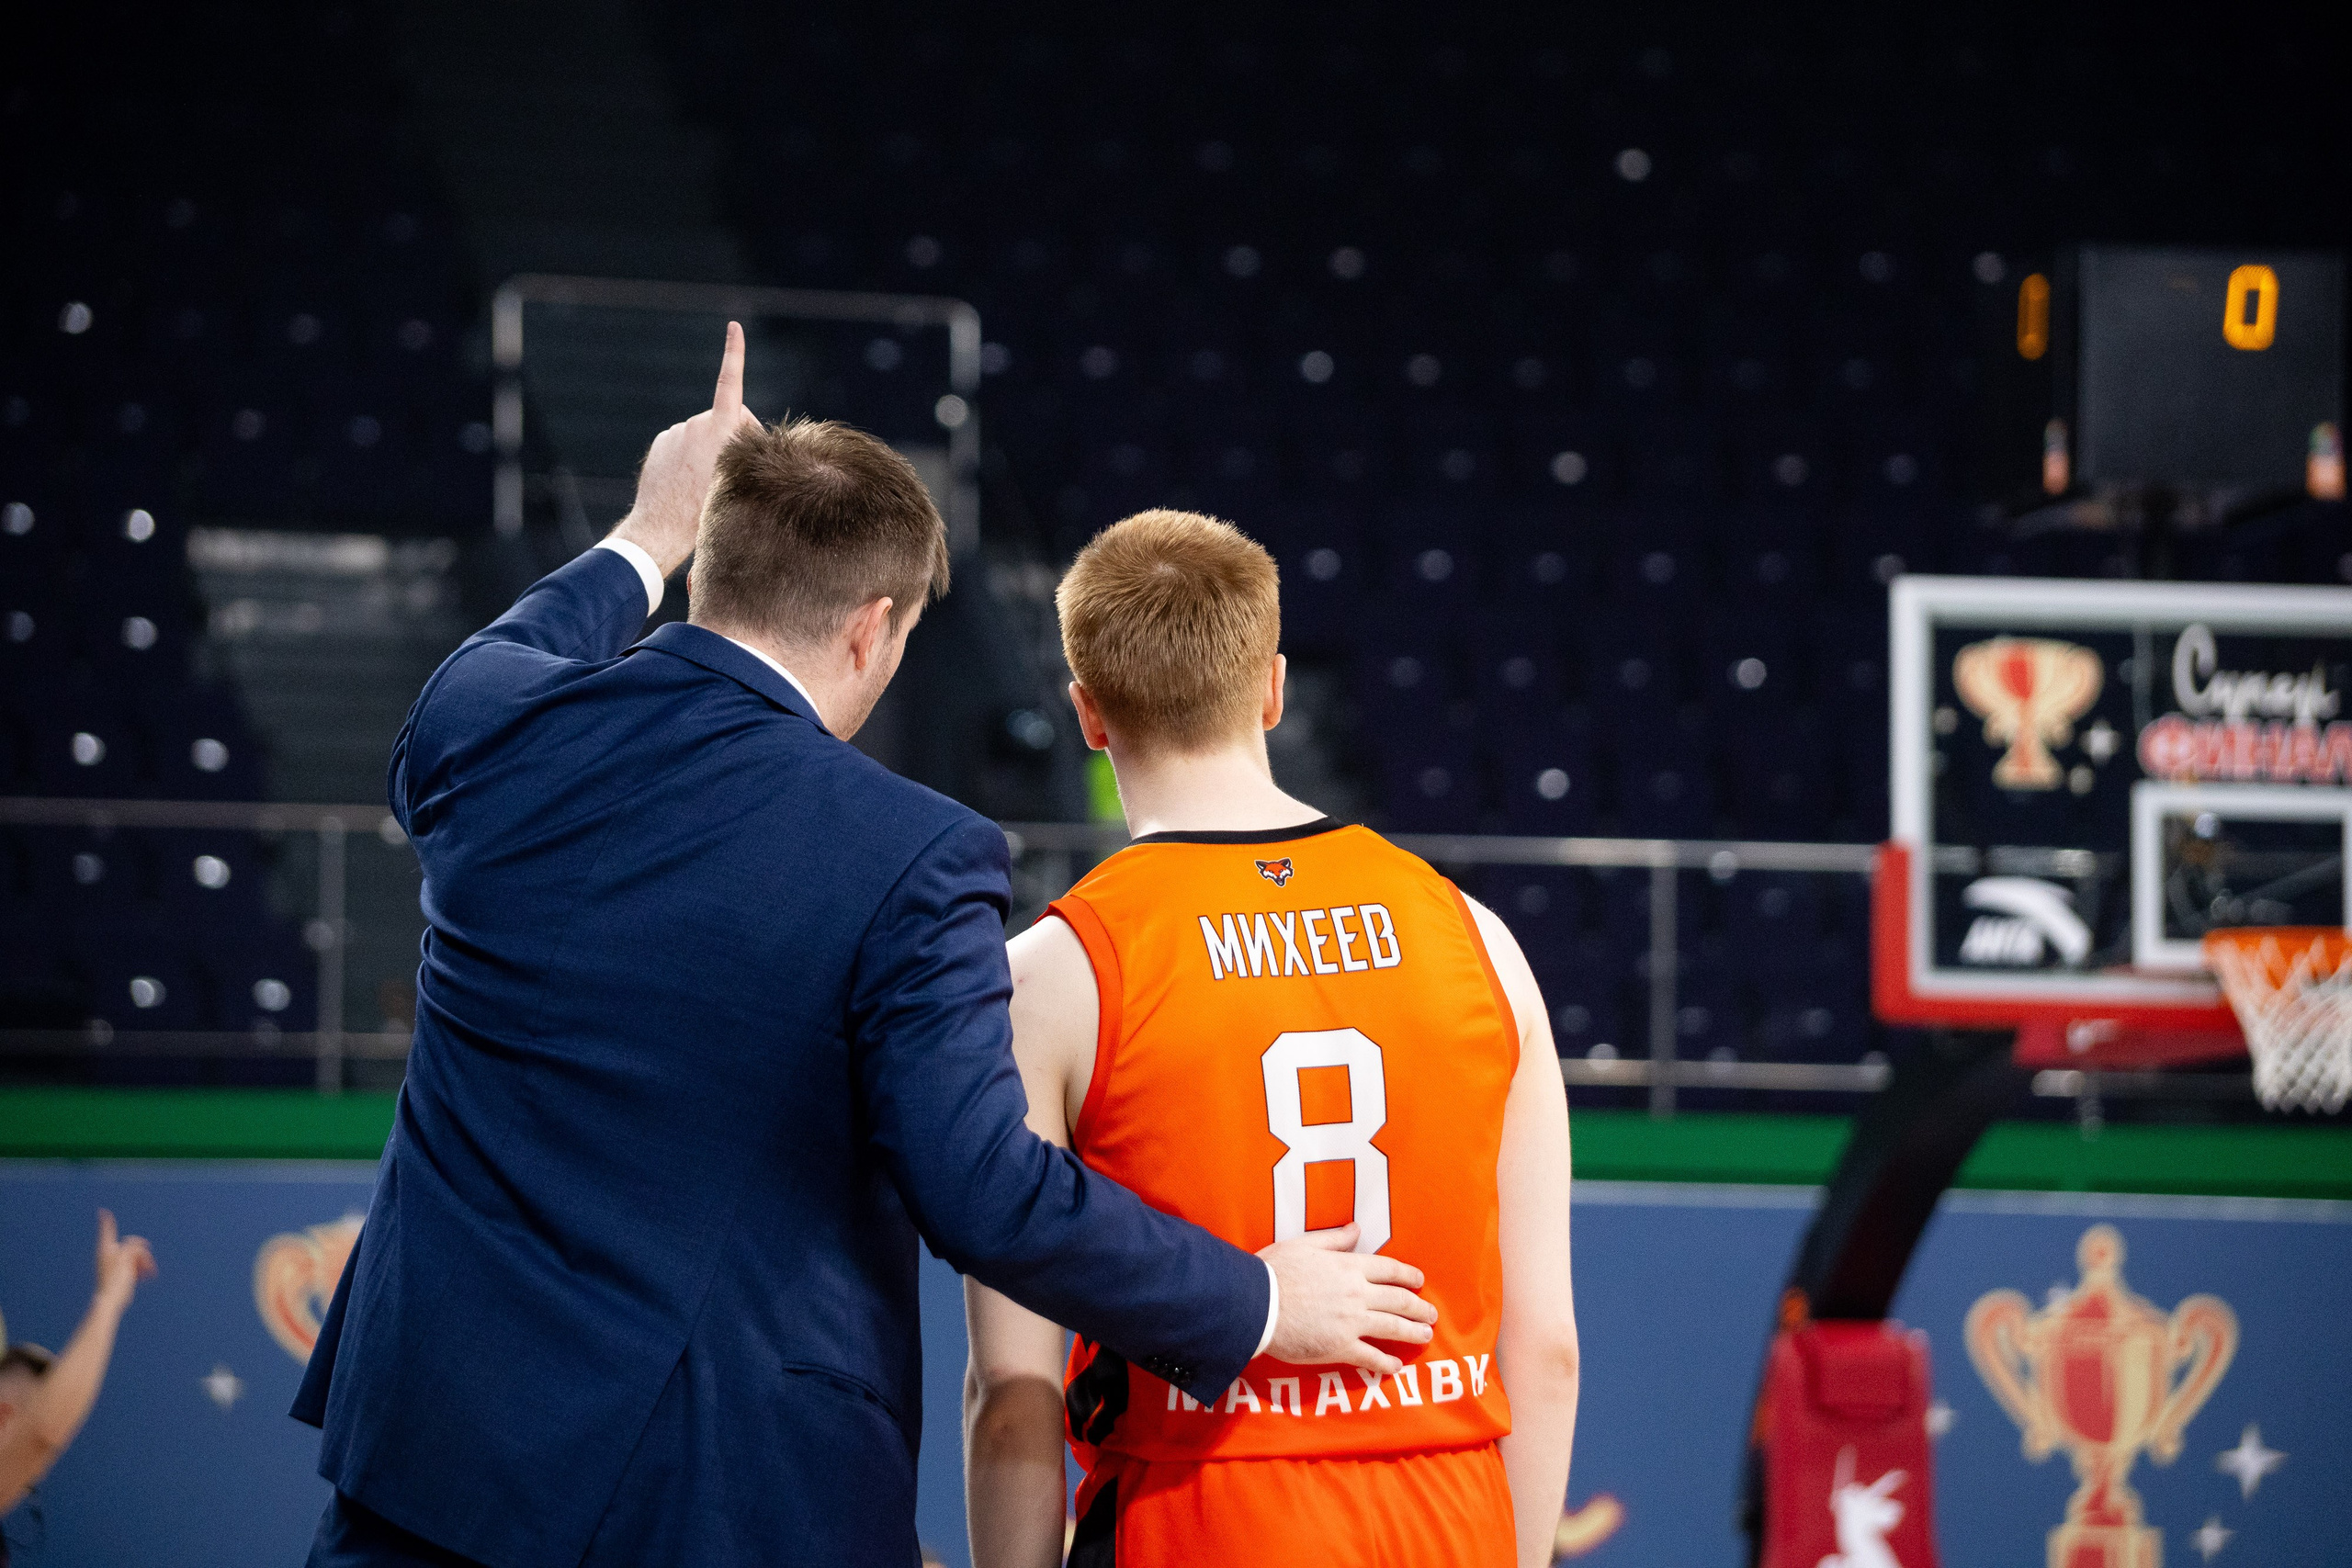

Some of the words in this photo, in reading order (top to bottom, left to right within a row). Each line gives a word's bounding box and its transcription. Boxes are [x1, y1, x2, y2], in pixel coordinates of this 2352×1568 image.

[2222, 264, 2279, 351] 0
[1197, 903, 1403, 980] МИХЕЕВ
[1261, 1027, 1392, 1255] 8
